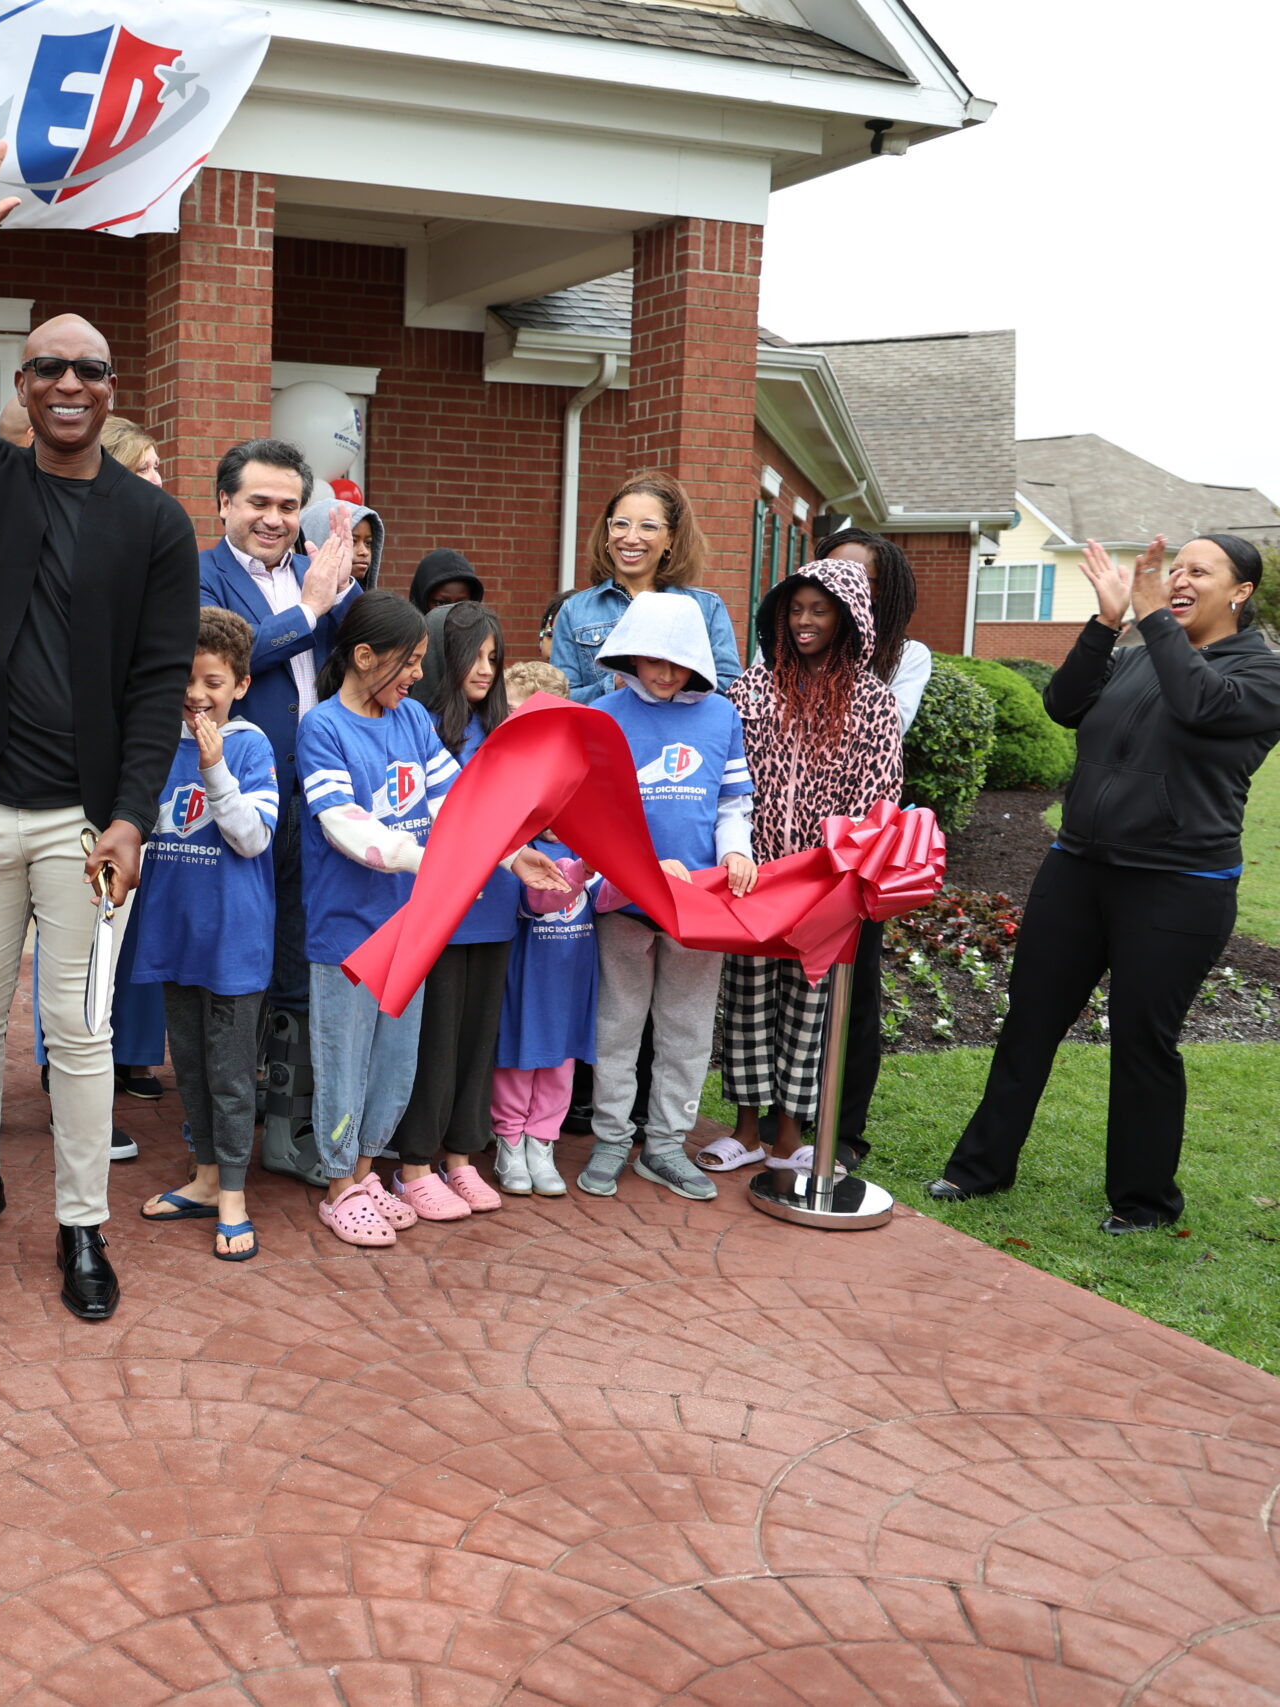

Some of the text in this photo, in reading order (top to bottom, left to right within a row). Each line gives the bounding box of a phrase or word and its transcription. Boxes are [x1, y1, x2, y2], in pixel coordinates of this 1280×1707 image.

[639, 785, 707, 795] RIC DICKERSON
[181, 855, 217, 866] CENTER
